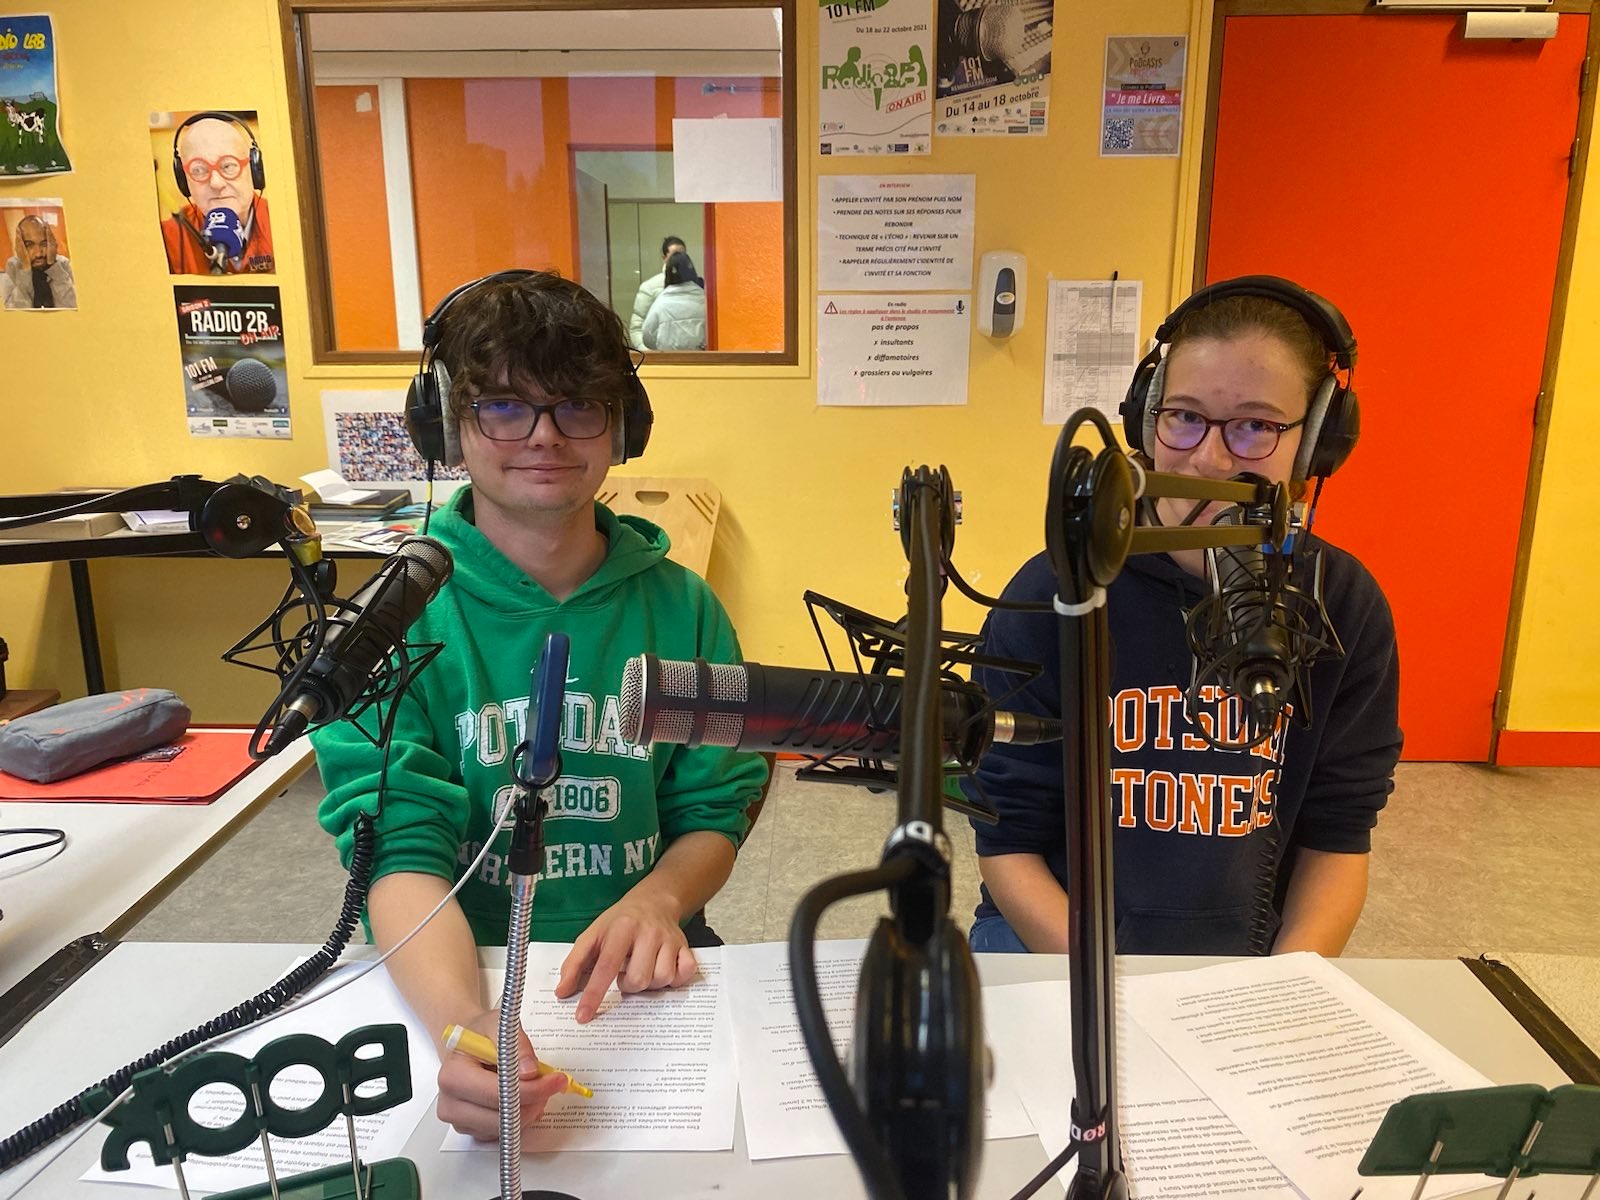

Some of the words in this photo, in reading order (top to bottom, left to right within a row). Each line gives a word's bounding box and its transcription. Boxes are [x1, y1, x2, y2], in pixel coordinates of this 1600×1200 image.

[826, 4, 851, 19] 101
[855, 0, 876, 14] FM
[961, 56, 982, 70] 101
[966, 68, 984, 82] FM
[946, 106, 960, 118] Du
[962, 102, 975, 114] 14
[977, 101, 990, 110] au
[994, 94, 1006, 108] 18
[1009, 90, 1040, 104] octobre
[1116, 94, 1126, 104] Je
[1127, 95, 1141, 104] me
[190, 310, 242, 332] RADIO
[246, 310, 268, 333] 2B
[241, 333, 258, 346] ON
[874, 354, 920, 362] diffamatoires
[185, 364, 202, 380] 101
[200, 356, 218, 374] FM
[860, 369, 890, 377] grossiers
[902, 369, 934, 377] vulgaires
[455, 691, 652, 776] POTDA
[554, 784, 610, 812] 1806
[1110, 768, 1283, 838] TONERS
